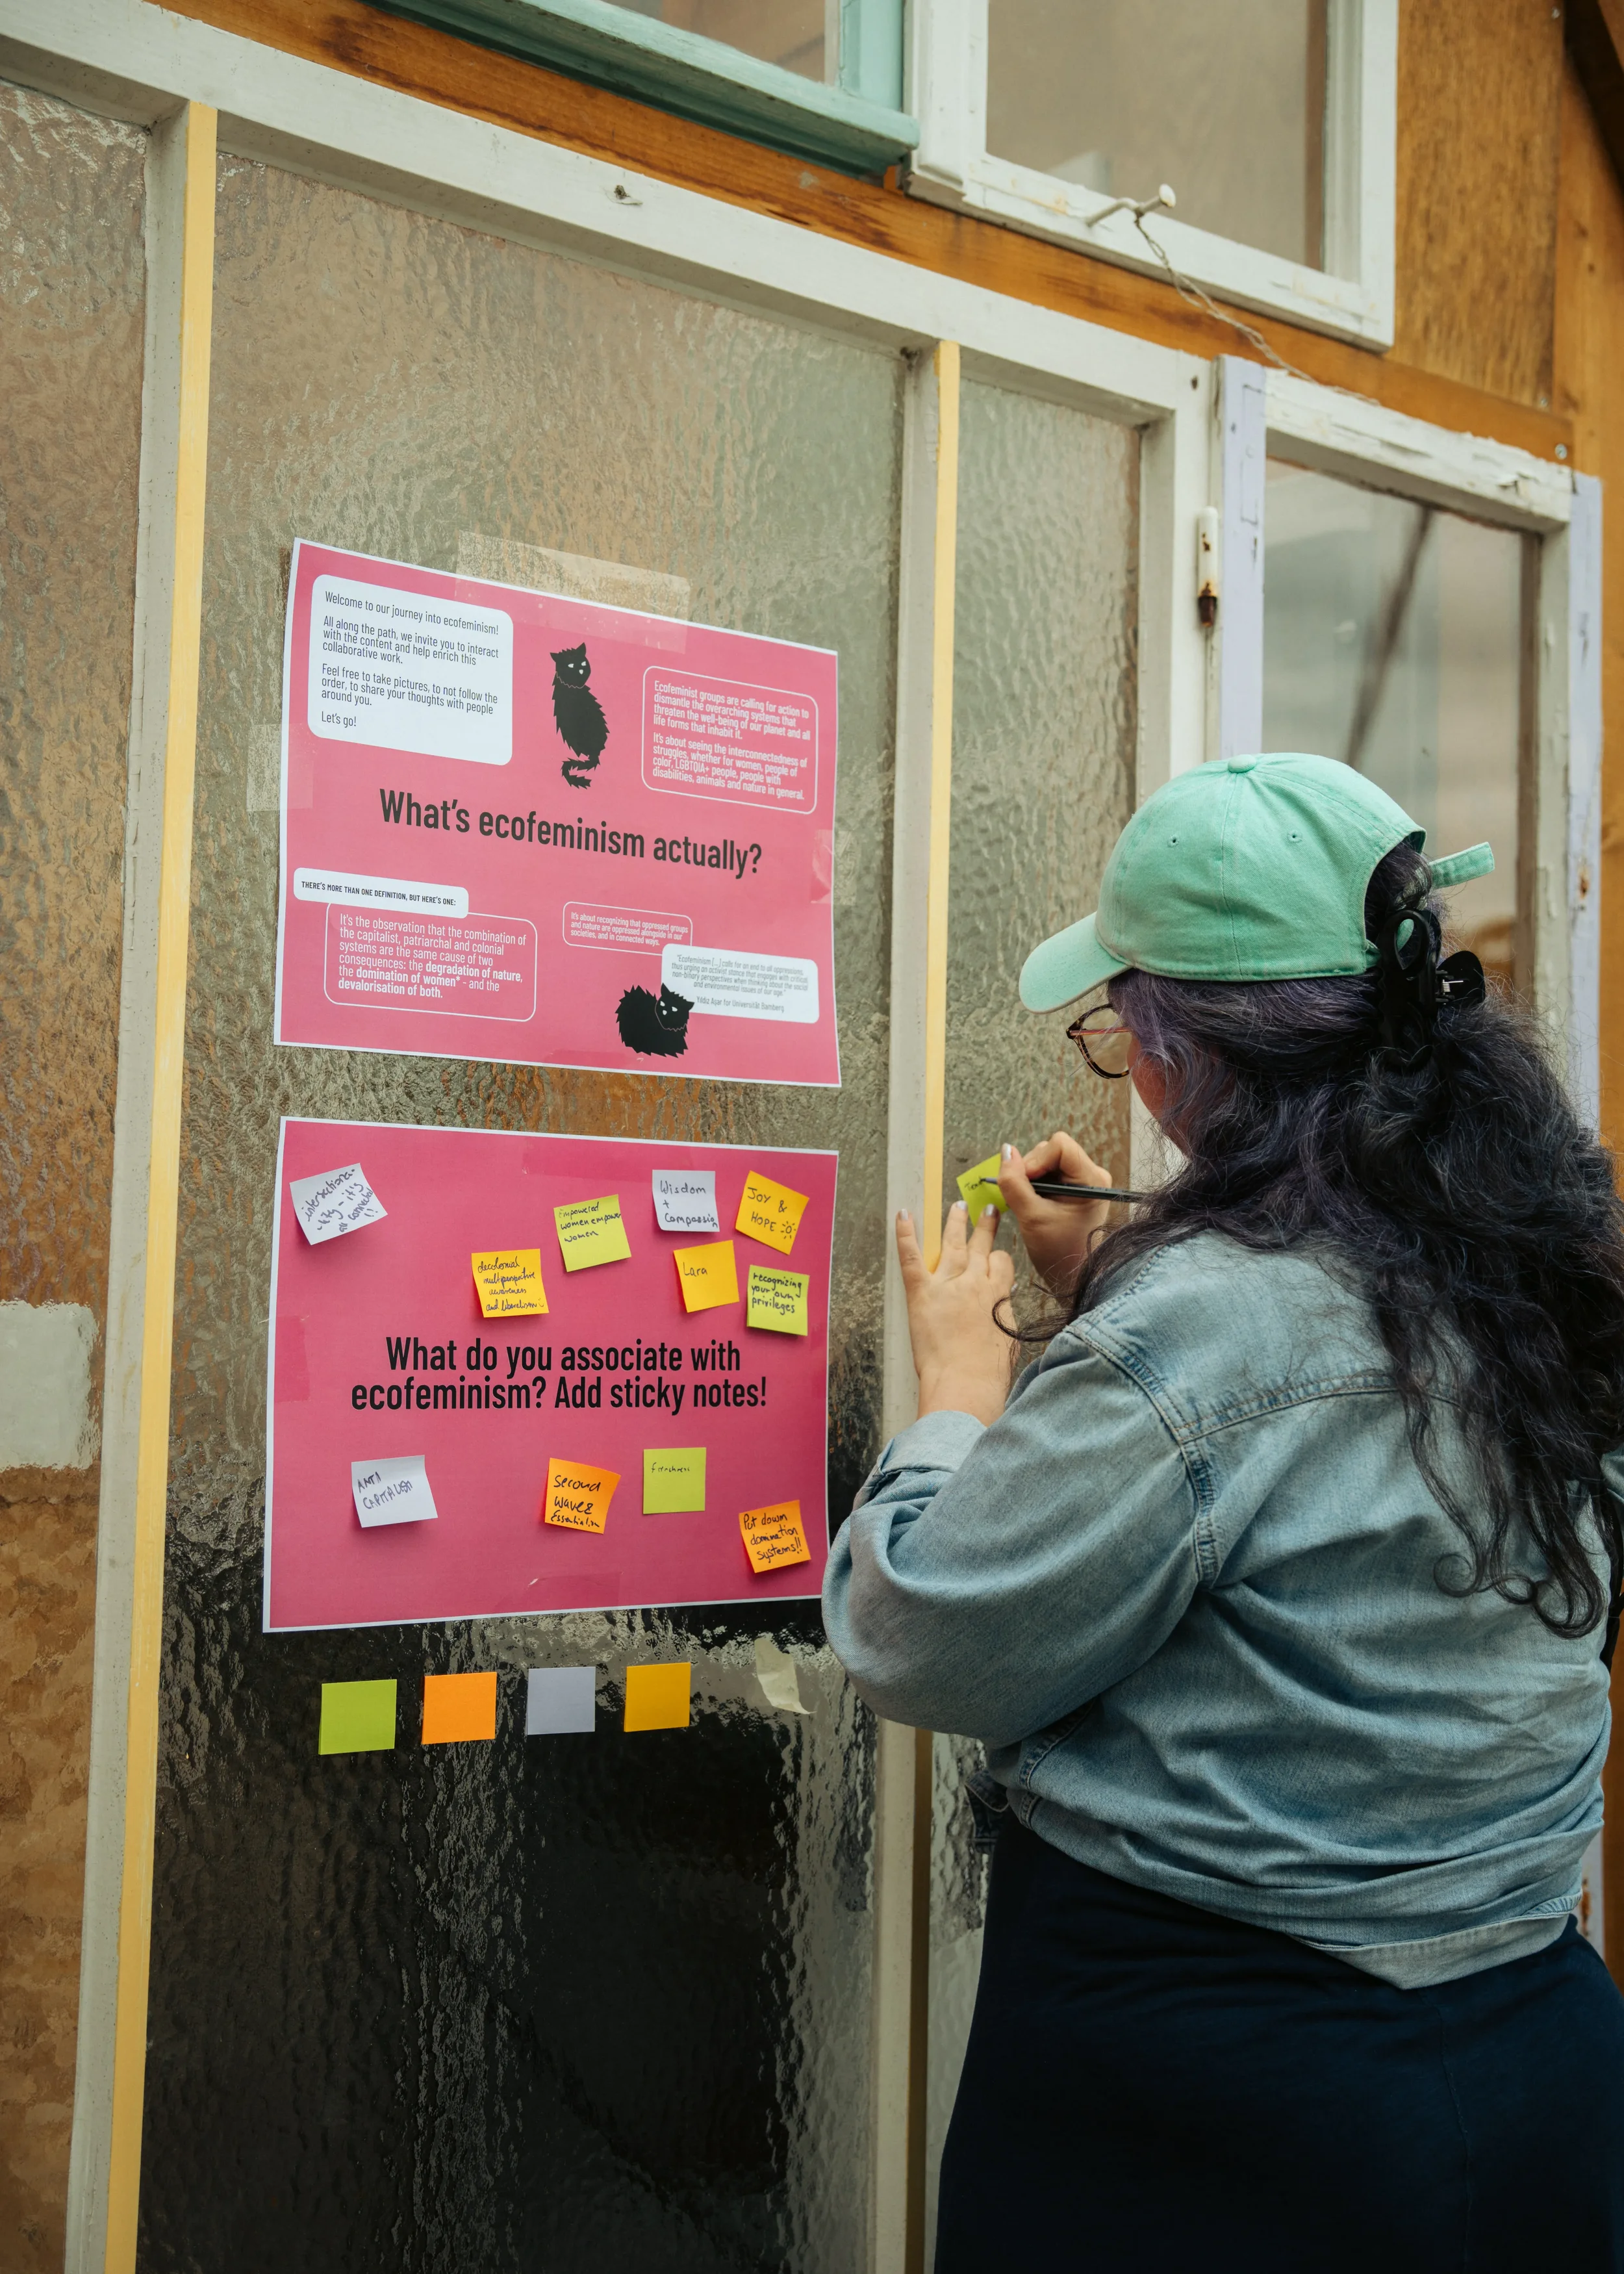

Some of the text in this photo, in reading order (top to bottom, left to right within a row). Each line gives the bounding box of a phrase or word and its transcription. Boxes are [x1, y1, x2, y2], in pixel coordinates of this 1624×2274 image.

[325, 591, 498, 634] Welcome to our journey into ecofeminism!
[324, 615, 498, 658] All along the path, we invite you to interact
[324, 629, 476, 665] with the content and help enrich this
[323, 641, 403, 663] collaborative work.
[323, 663, 497, 702] Feel free to take pictures, to not follow the
[322, 678, 492, 715] order, to share your thoughts with people
[322, 690, 372, 706] around you.
[655, 681, 809, 718] Ecofeminist groups are calling for action to
[322, 711, 356, 728] Let's go!
[379, 789, 761, 880] What's ecofeminism actually?
[301, 881, 325, 890] THERE'S
[375, 889, 407, 901] DEFINITION,
[422, 895, 441, 904] HERE'S
[340, 913, 526, 945] It's the observation that the combination of
[597, 917, 628, 928] recognizing
[642, 922, 668, 930] oppressed
[670, 925, 688, 934] groups
[340, 926, 503, 954] the capitalist, patriarchal and colonial
[340, 941, 492, 965] systems are the same cause of two
[339, 954, 522, 982] consequences: the degradation of nature,
[339, 965, 353, 977] the
[357, 966, 408, 982] domination
[411, 972, 420, 983] of
[469, 978, 483, 989] and
[487, 979, 499, 991] the
[338, 977, 442, 997] devalorisation of both.
[661, 1180, 706, 1194] Wisdom
[778, 1200, 787, 1212] &
[591, 1213, 620, 1224] empower
[752, 1212, 776, 1231] HOPE
[683, 1262, 707, 1277] Lara
[752, 1285, 793, 1301] your own
[754, 1273, 802, 1298] recognizing
[487, 1299, 499, 1311] and
[752, 1296, 794, 1315] privileges
[387, 1337, 741, 1378] What do you associate with
[351, 1375, 766, 1415] ecofeminism? Add sticky notes!
[744, 1514, 757, 1529] Put
[751, 1524, 798, 1545] domination
